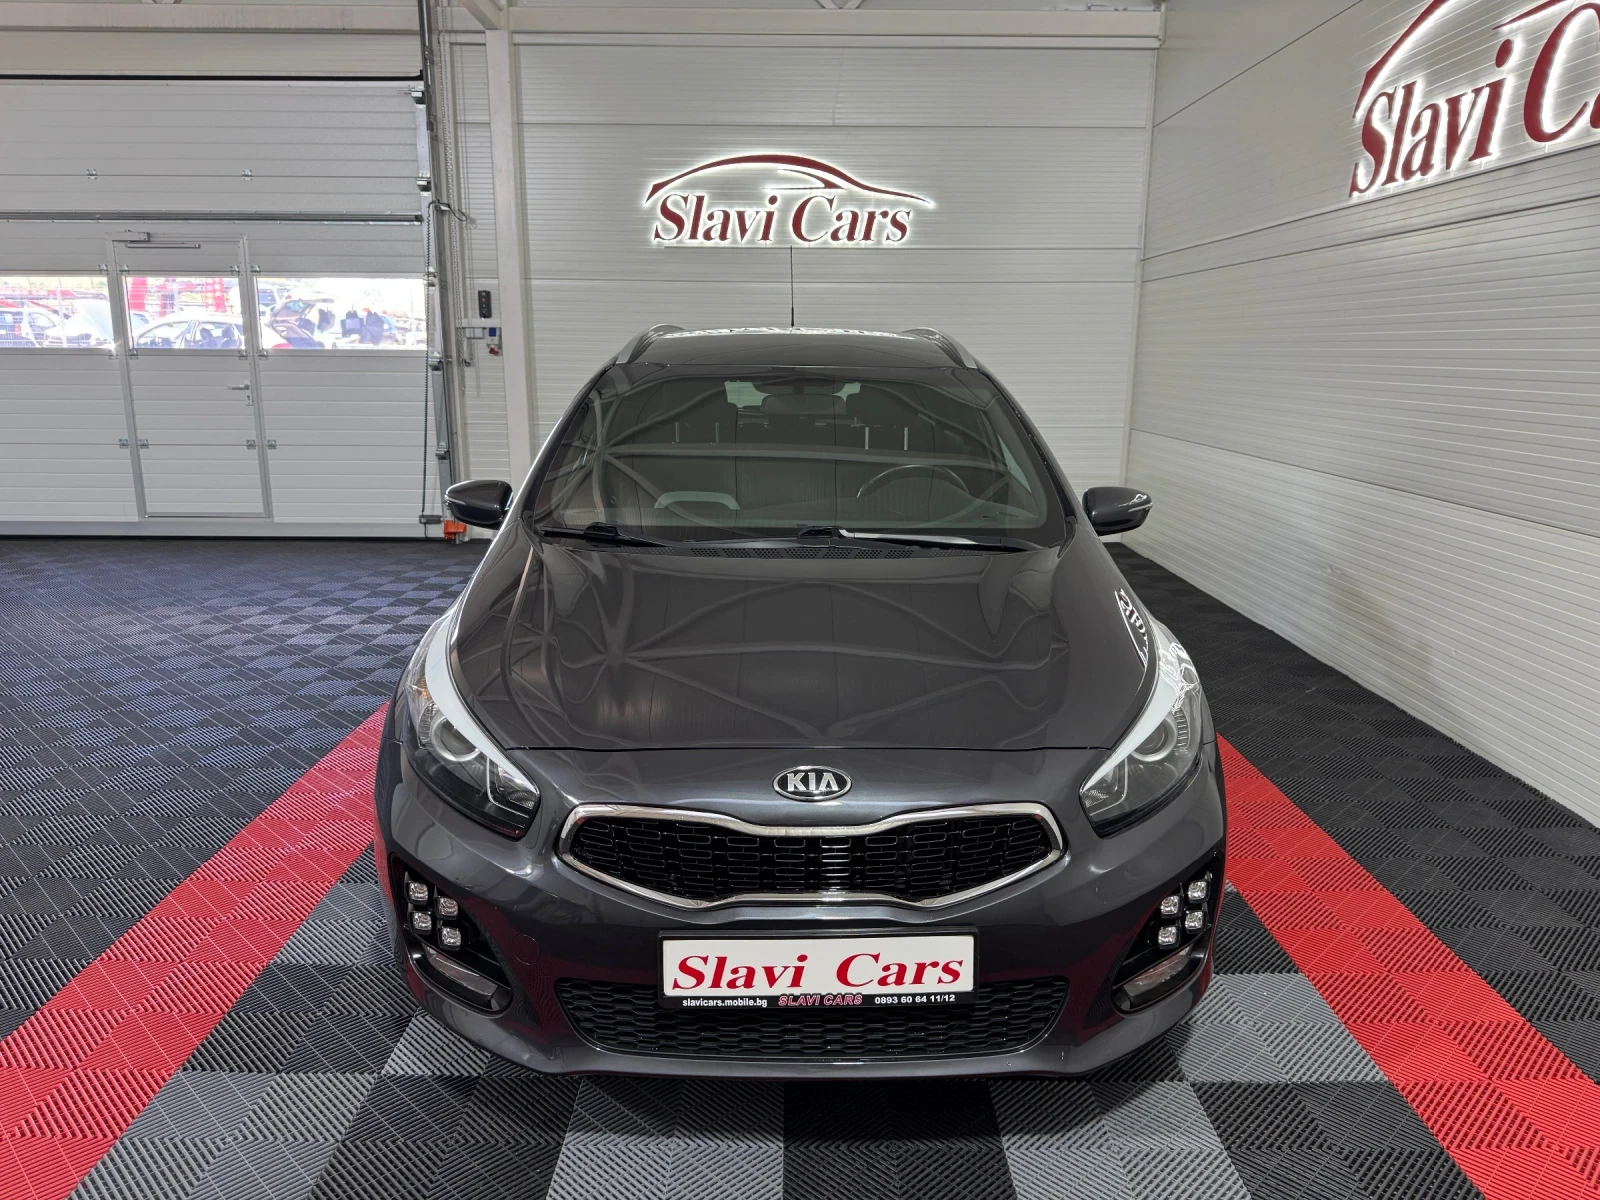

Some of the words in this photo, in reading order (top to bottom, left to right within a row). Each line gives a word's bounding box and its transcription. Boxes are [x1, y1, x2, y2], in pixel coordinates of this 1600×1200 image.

[1347, 38, 1514, 198] Slavi
[1523, 1, 1600, 143] C
[653, 193, 778, 242] Slavi
[791, 194, 912, 243] Cars
[786, 772, 839, 792] KIA
[671, 953, 809, 991] Slavi
[835, 952, 964, 988] Cars
[682, 997, 768, 1008] slavicars.mobile.bg
[778, 995, 820, 1007] SLAVI
[823, 994, 863, 1006] CARS
[874, 996, 899, 1005] 0893
[900, 995, 913, 1004] 60
[914, 995, 928, 1003] 64
[929, 994, 956, 1003] 11/12
